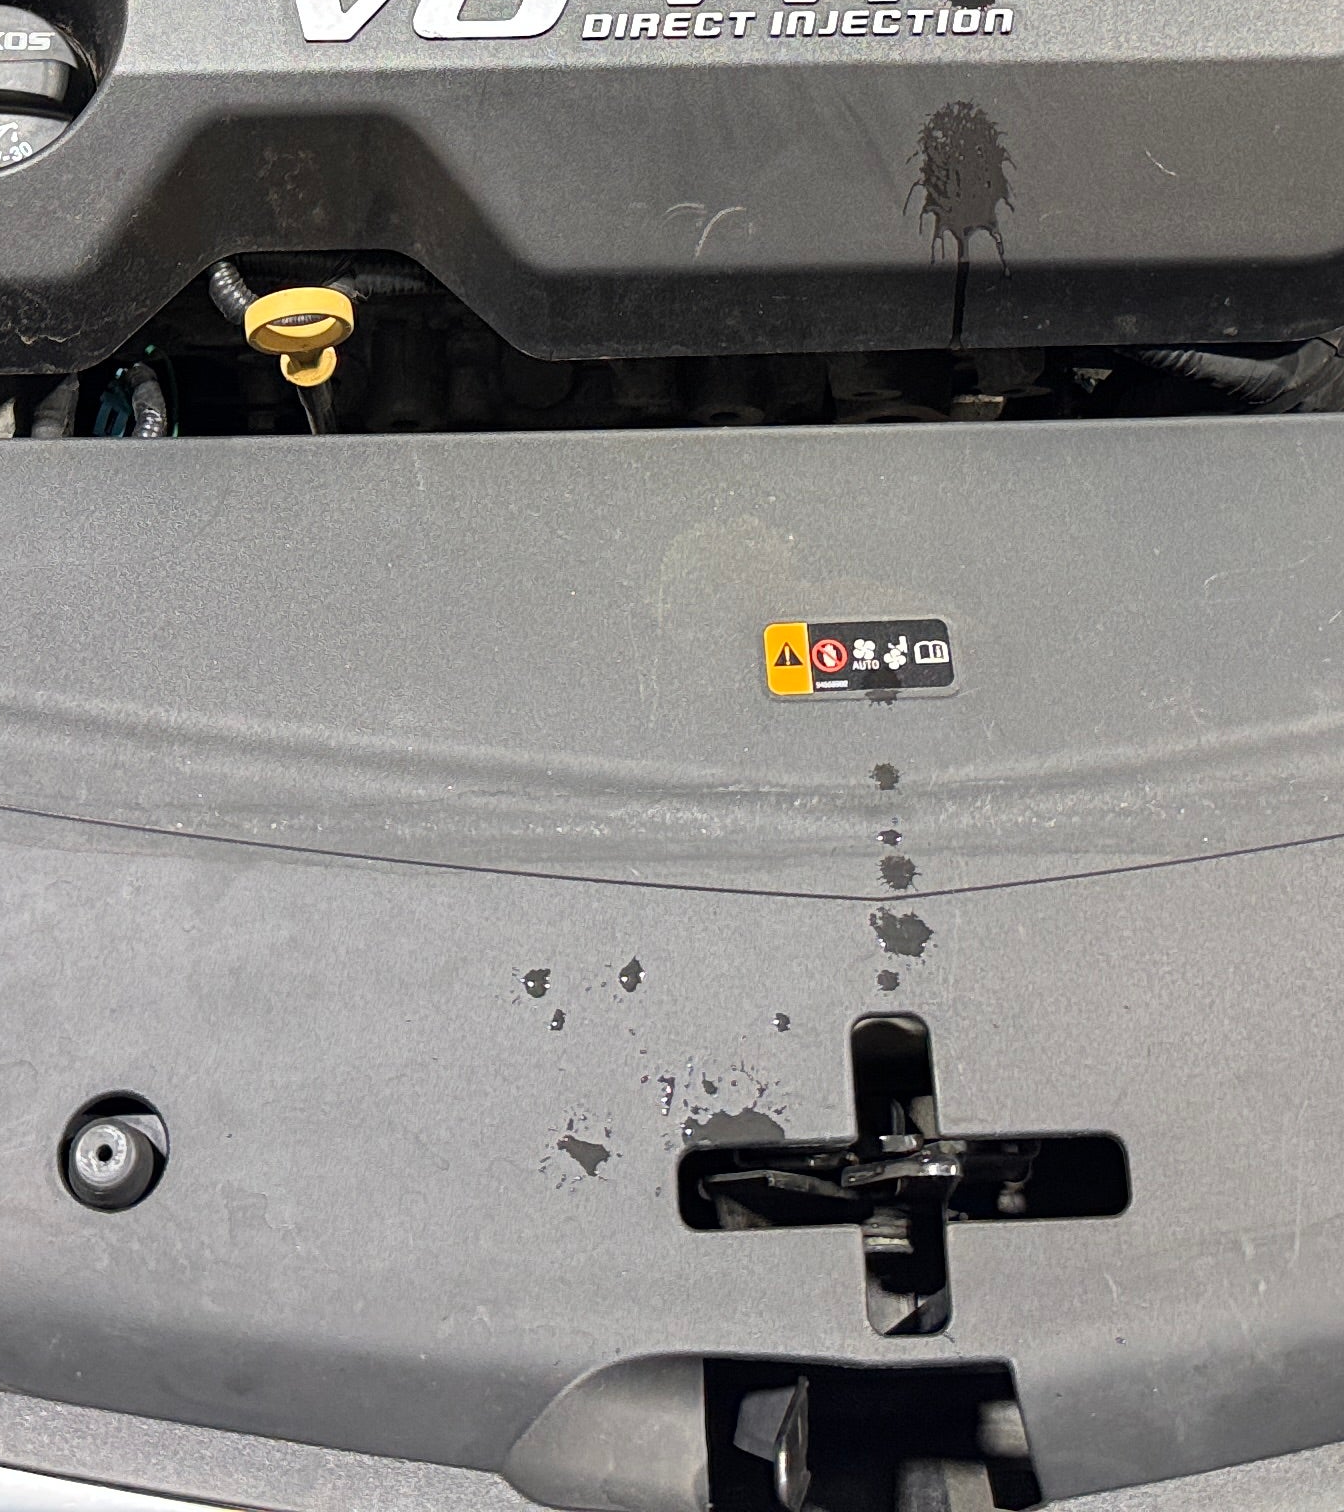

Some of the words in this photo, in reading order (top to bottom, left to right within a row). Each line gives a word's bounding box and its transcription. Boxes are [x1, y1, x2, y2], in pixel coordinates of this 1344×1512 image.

[581, 12, 756, 39] DIRECT
[770, 8, 1015, 37] INJECTION
[852, 660, 880, 670] AUTO
